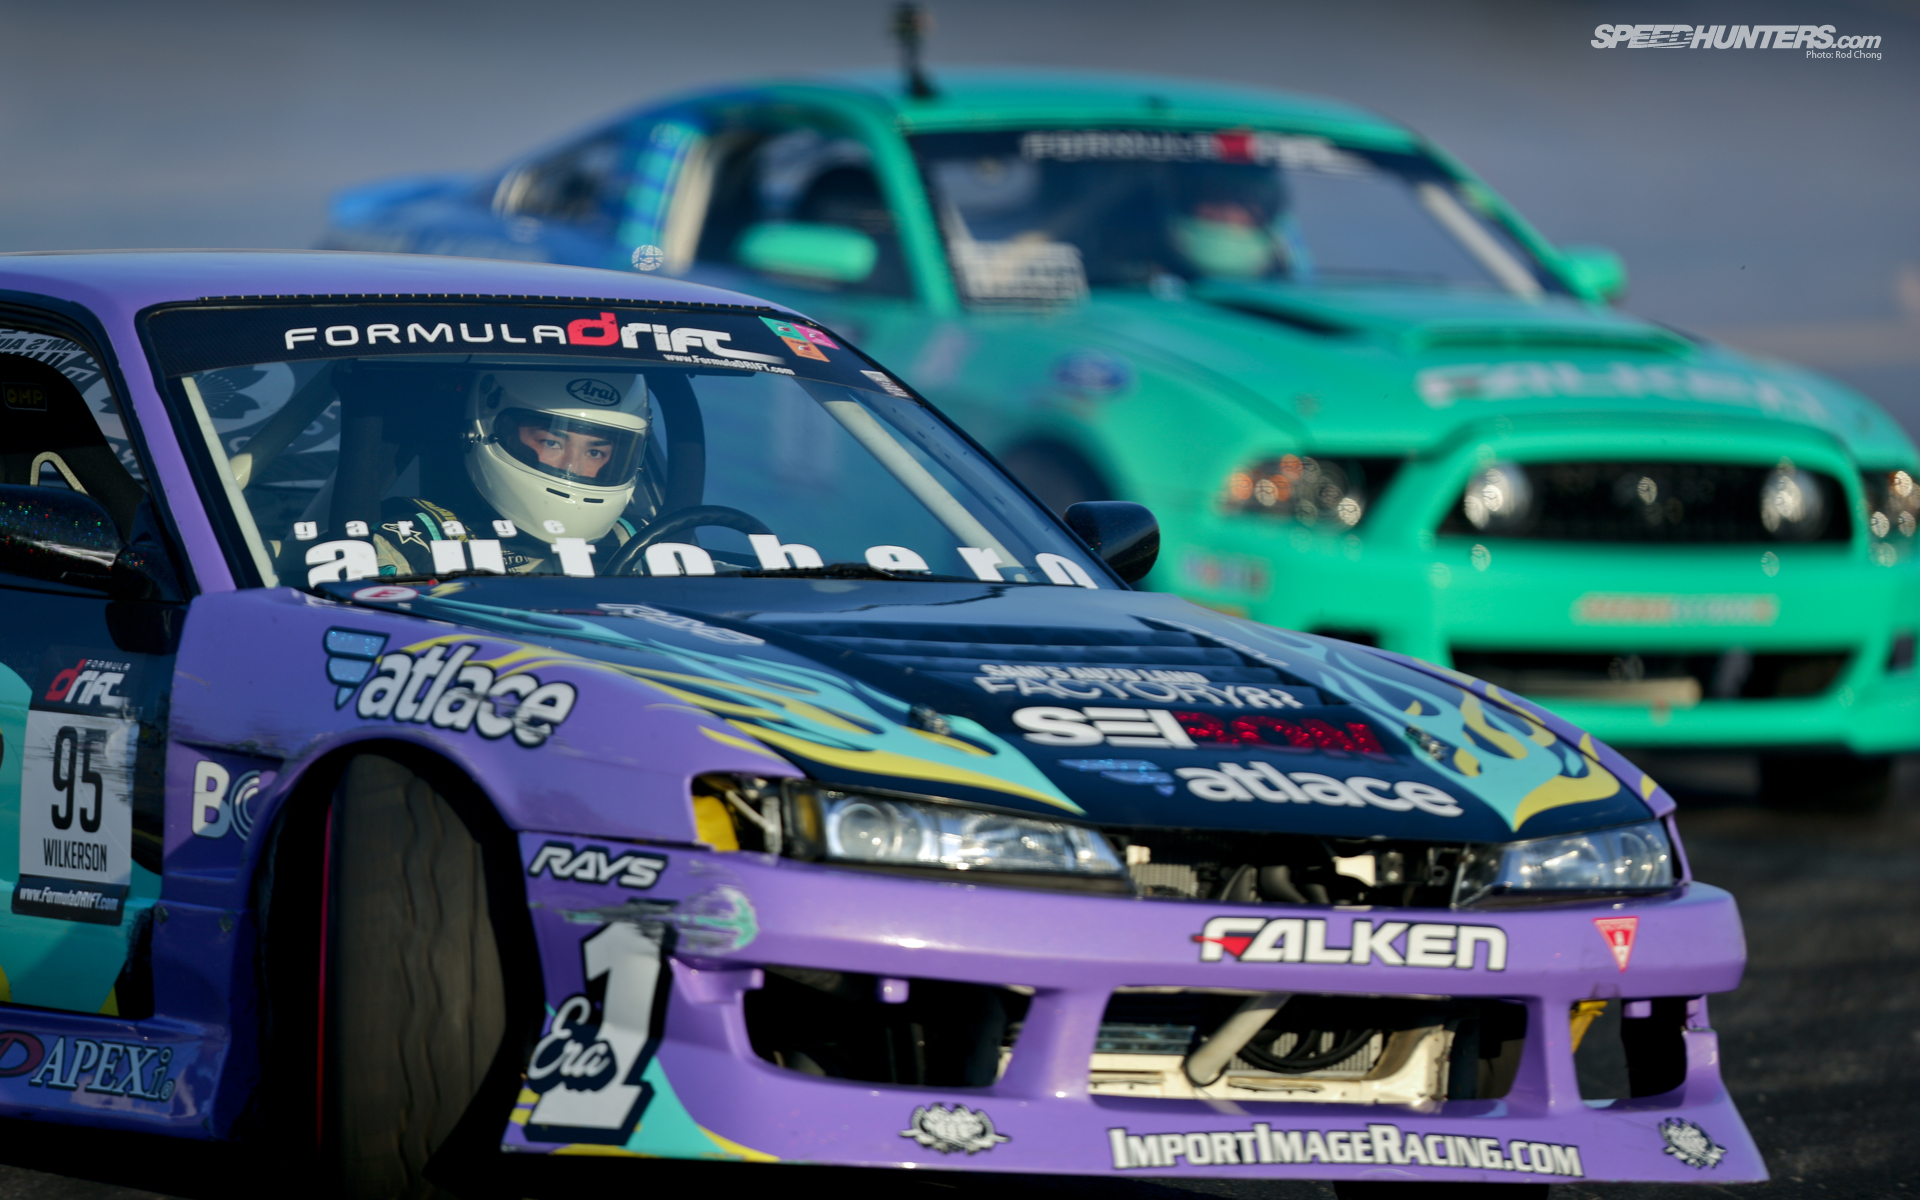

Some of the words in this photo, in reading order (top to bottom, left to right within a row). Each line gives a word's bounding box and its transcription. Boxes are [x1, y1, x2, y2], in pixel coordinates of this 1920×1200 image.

[284, 322, 567, 350] FORMULA
[570, 380, 617, 402] Arai
[85, 659, 132, 673] FORMULA
[356, 643, 577, 748] atlace
[51, 725, 103, 833] 95
[1176, 761, 1464, 817] atlace
[43, 838, 107, 872] WILKERSON
[527, 845, 666, 887] RAYS
[1193, 916, 1507, 970] FALKEN
